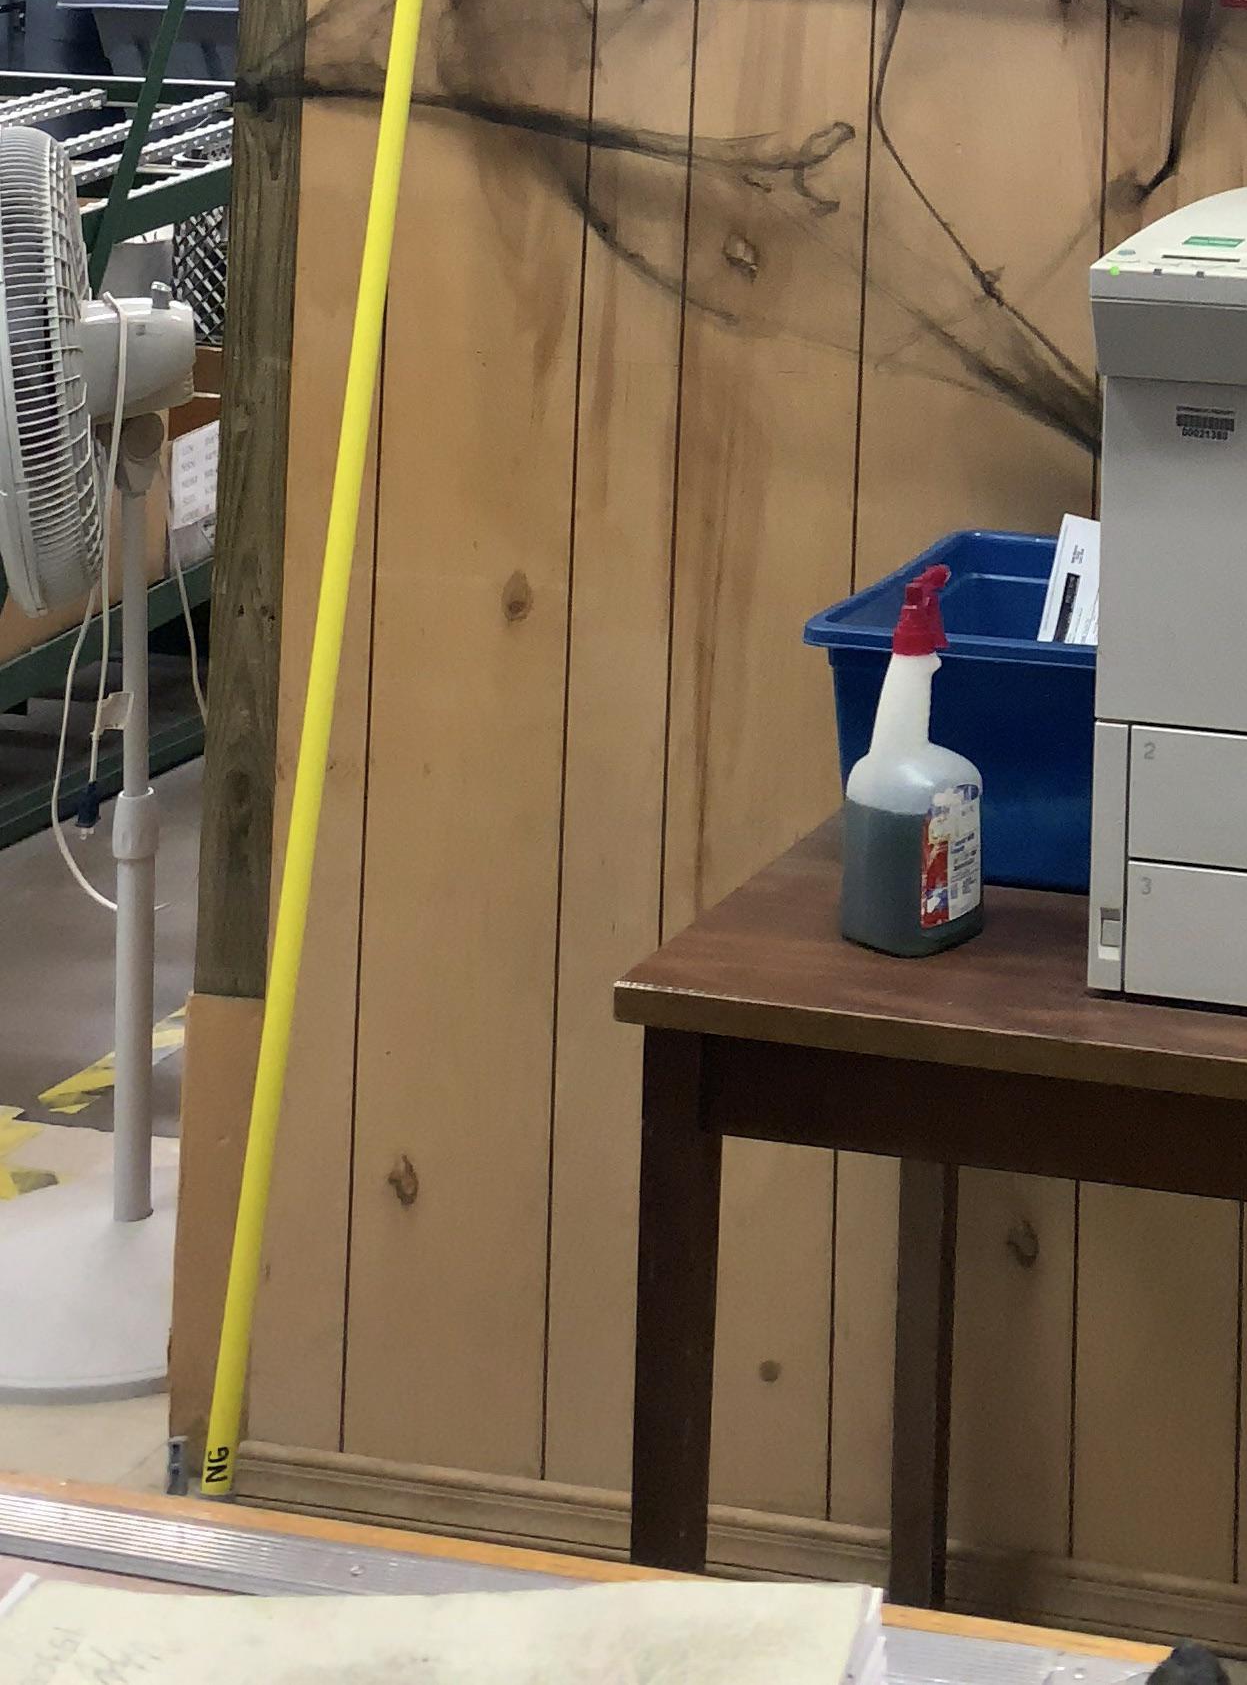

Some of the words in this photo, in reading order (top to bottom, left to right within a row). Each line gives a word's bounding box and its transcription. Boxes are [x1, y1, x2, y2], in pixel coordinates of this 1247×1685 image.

[1143, 741, 1157, 761] 2
[1142, 877, 1153, 896] 3
[205, 1446, 230, 1484] NG
